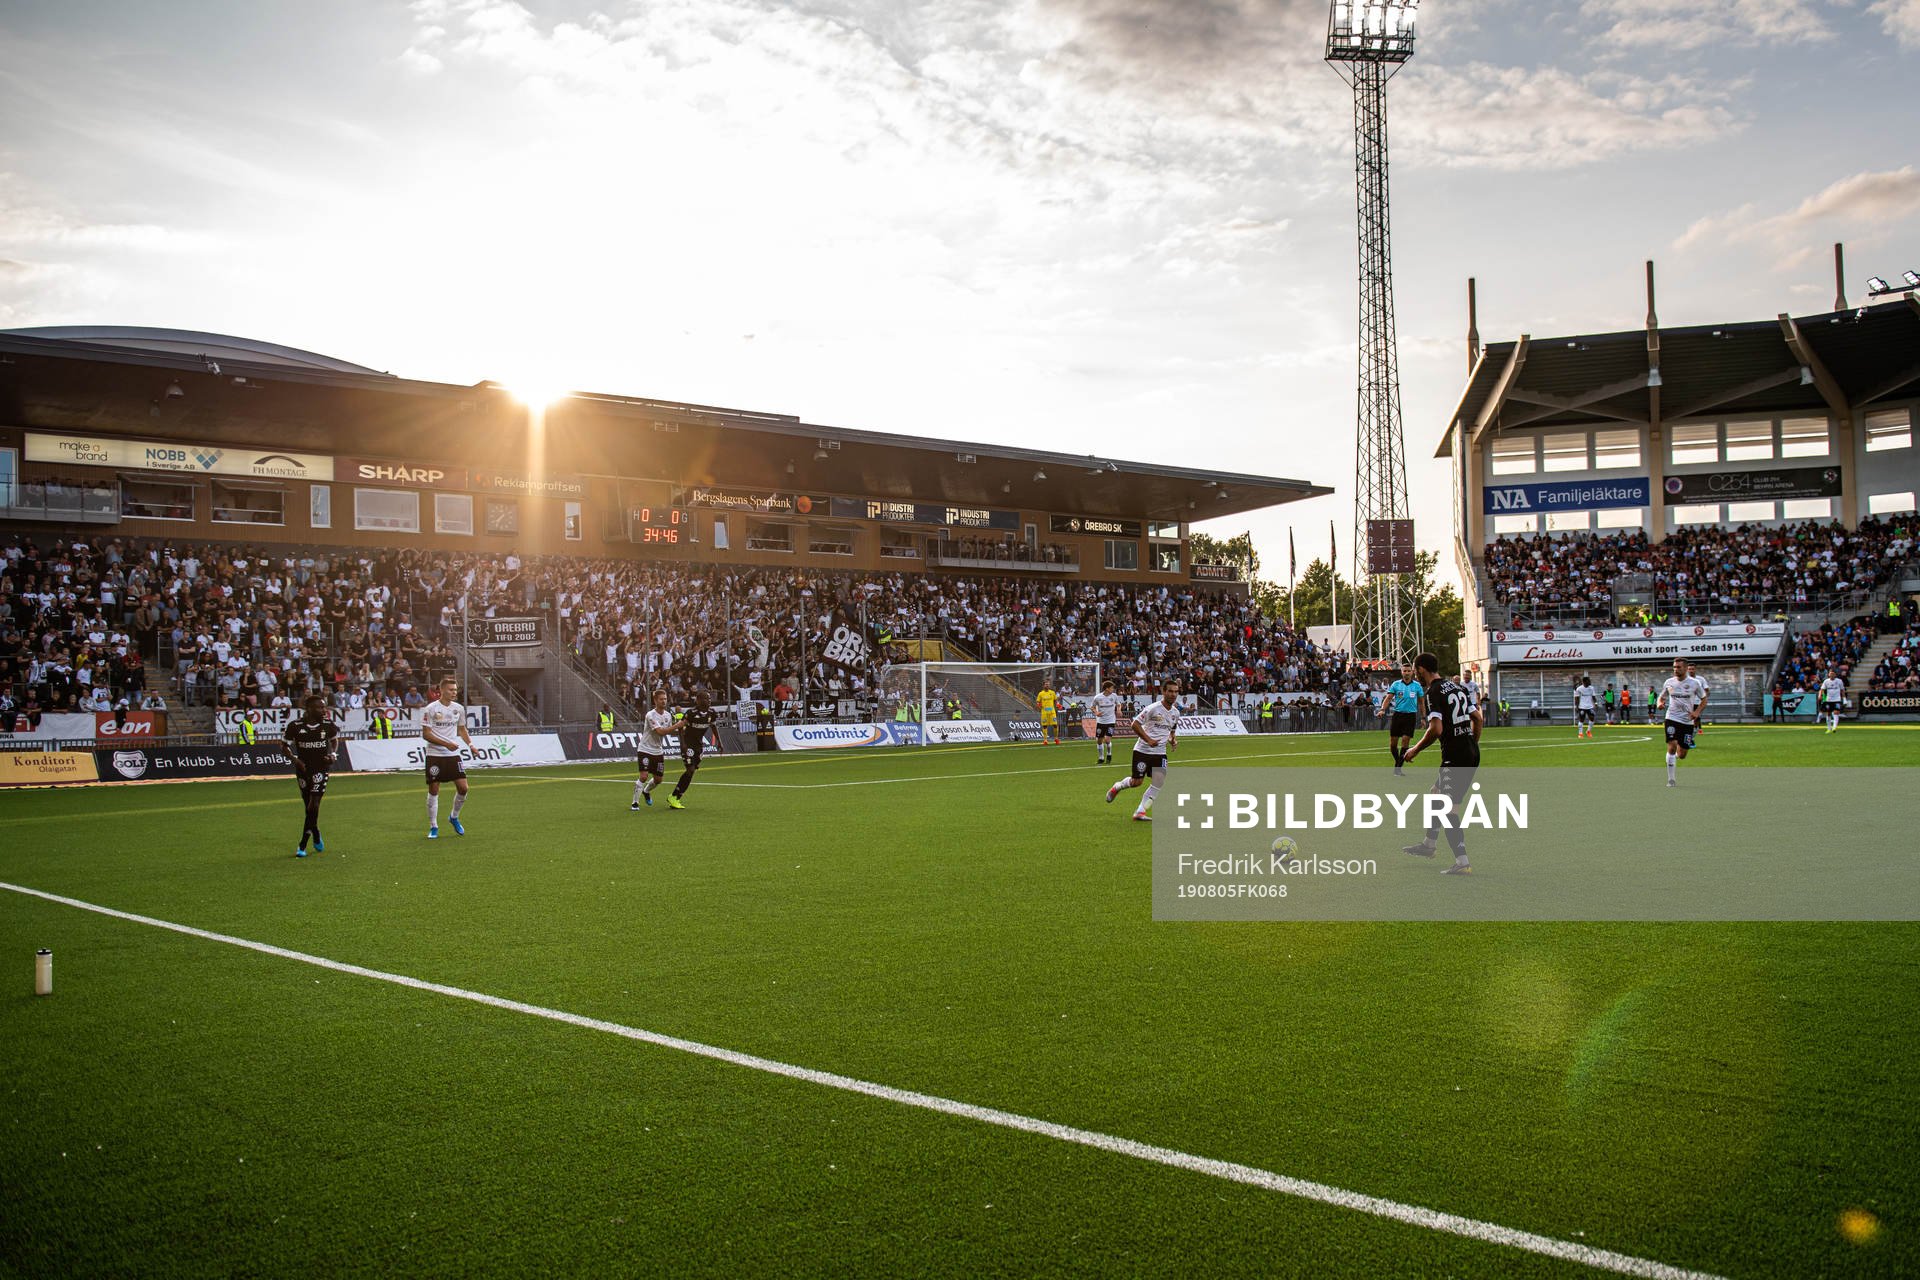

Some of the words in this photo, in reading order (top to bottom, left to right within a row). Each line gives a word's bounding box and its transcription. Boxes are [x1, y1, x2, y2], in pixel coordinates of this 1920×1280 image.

[59, 441, 90, 451] make
[76, 451, 107, 461] brand
[146, 448, 186, 461] NOBB
[152, 462, 180, 470] Sverige
[253, 467, 265, 475] FH
[266, 468, 307, 477] MONTAGE
[358, 464, 445, 483] SHARP
[693, 490, 748, 506] Bergslagens
[750, 494, 791, 509] Sparbank
[1491, 489, 1531, 510] NA
[1538, 487, 1642, 504] Familjeläktare
[882, 502, 914, 513] INDUSTRI
[641, 508, 650, 522] 0
[671, 510, 679, 524] 0
[882, 512, 914, 521] PRODUKTER
[960, 509, 990, 519] INDUSTRI
[960, 518, 989, 527] PRODUKTER
[1084, 520, 1112, 532] ÖREBRO
[1113, 523, 1122, 533] SK
[643, 528, 678, 543] 34:46
[515, 632, 536, 641] 2002
[1523, 646, 1583, 659] Lindells
[1612, 646, 1622, 654] Vi
[1625, 645, 1652, 654] älskar
[1655, 644, 1678, 654] sport
[1690, 643, 1717, 652] sedan
[1722, 643, 1745, 651] 1914
[1448, 691, 1470, 725] 22
[931, 725, 961, 734] Carlsson
[970, 724, 992, 735] Åqvist
[1009, 720, 1041, 730] ÖREBRO
[792, 728, 869, 740] Combimix
[13, 756, 76, 766] Konditori
[115, 760, 148, 768] GOLF
[155, 758, 173, 768] En
[178, 755, 215, 767] klubb
[230, 753, 251, 766] två
[256, 754, 292, 765] anläg
[39, 766, 76, 774] Olaigatan
